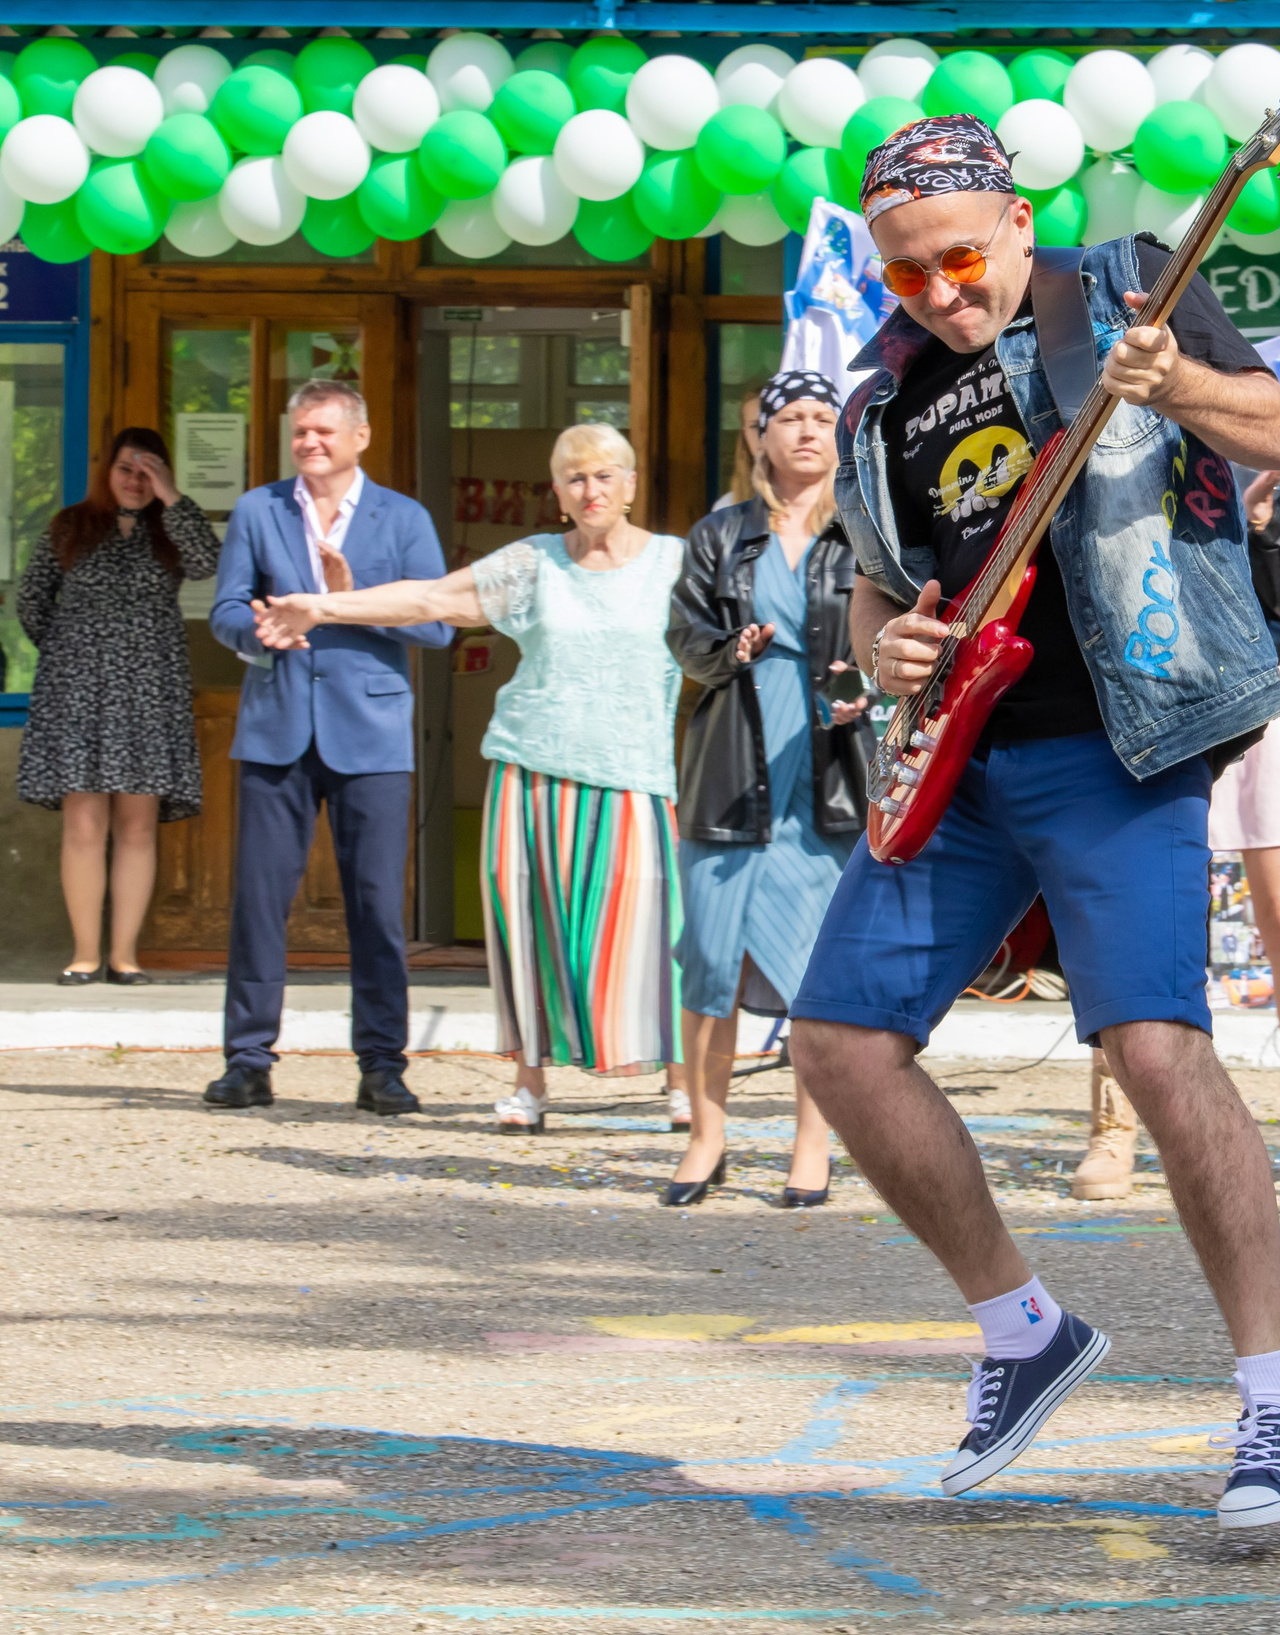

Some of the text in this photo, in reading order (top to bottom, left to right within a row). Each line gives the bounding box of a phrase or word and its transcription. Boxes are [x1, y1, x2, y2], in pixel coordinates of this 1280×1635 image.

[905, 371, 1010, 442] DOPAM
[949, 404, 1004, 435] DUAL MODE
[1124, 540, 1179, 679] ROCK
